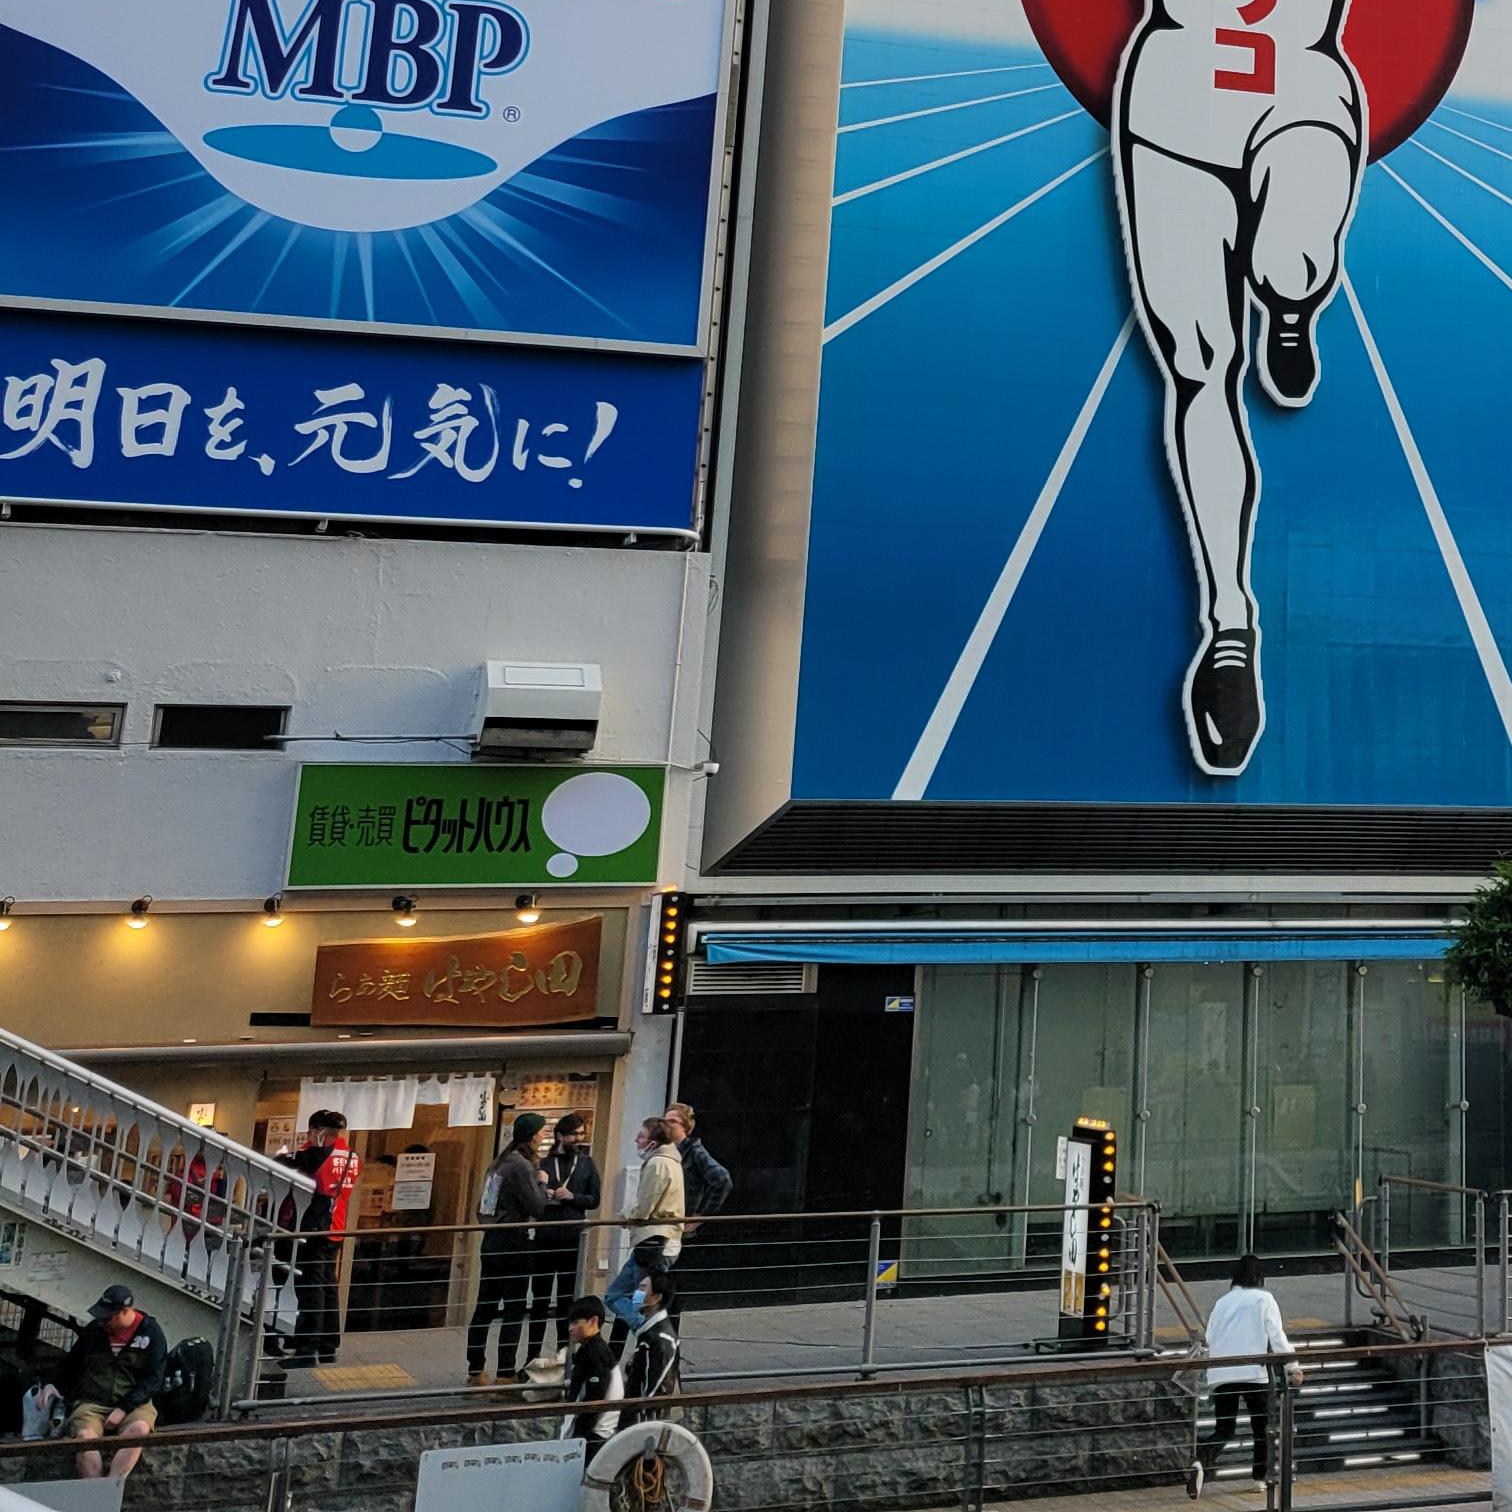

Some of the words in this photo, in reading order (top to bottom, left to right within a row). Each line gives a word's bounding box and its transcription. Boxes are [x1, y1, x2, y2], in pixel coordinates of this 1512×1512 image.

[402, 795, 532, 855] ピタットハウス
